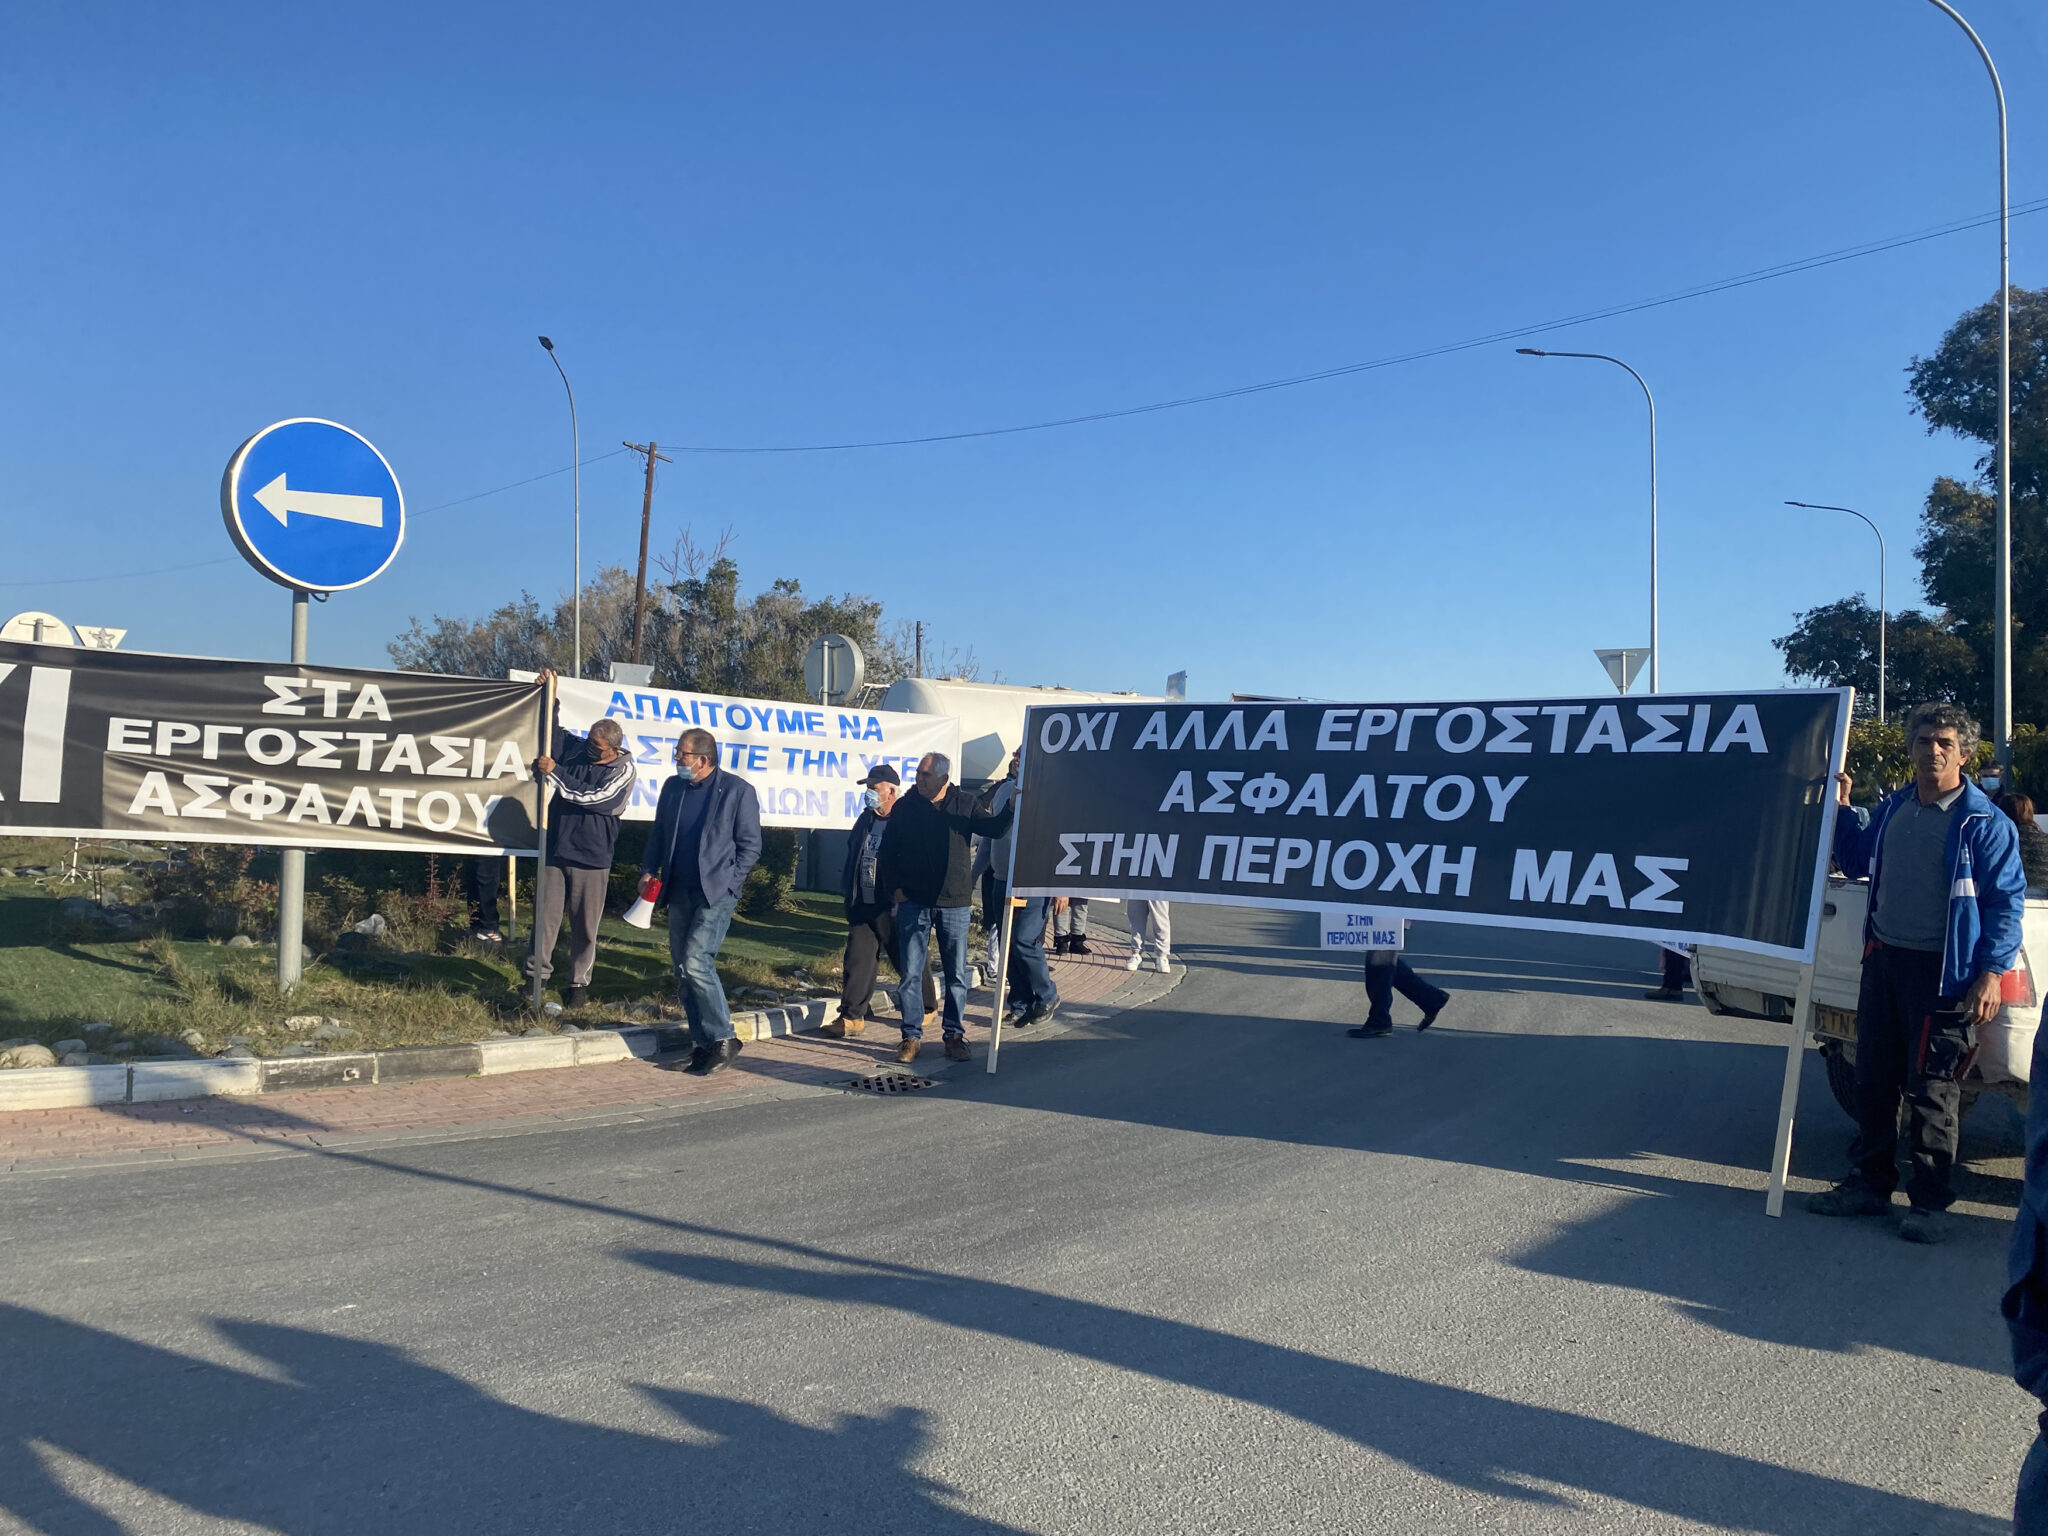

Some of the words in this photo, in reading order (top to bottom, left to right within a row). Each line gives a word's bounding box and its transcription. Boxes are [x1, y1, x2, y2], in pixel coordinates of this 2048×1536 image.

[261, 675, 392, 722] ΣΤΑ
[605, 691, 826, 738] ΑΠΑΙΤΟΥΜΕ
[838, 715, 884, 742] ΝΑ
[107, 716, 530, 782] ΕΡΓΟΣΤΑΣΙΑ
[1040, 711, 1120, 755] ΟΧΙ
[1132, 709, 1290, 752] ΑΛΛΑ
[1315, 704, 1770, 755] ΕΡΓΟΣΤΑΣΙΑ
[782, 747, 849, 779] ΤΗΝ
[128, 771, 504, 835] ΑΣΦΑΛΤΟΥ
[1158, 770, 1530, 823] ΑΣΦΑΛΤΟΥ
[1054, 832, 1180, 879] ΣΤΗΝ
[1198, 834, 1477, 898] ΠΕΡΙΟΧΗ
[1509, 848, 1690, 914] ΜΑΣ
[1326, 931, 1369, 945] ΠΕΡΙΟΧΗ
[1372, 930, 1396, 945] ΜΑΣ
[1346, 914, 1374, 927] ΣΤΗΝ
